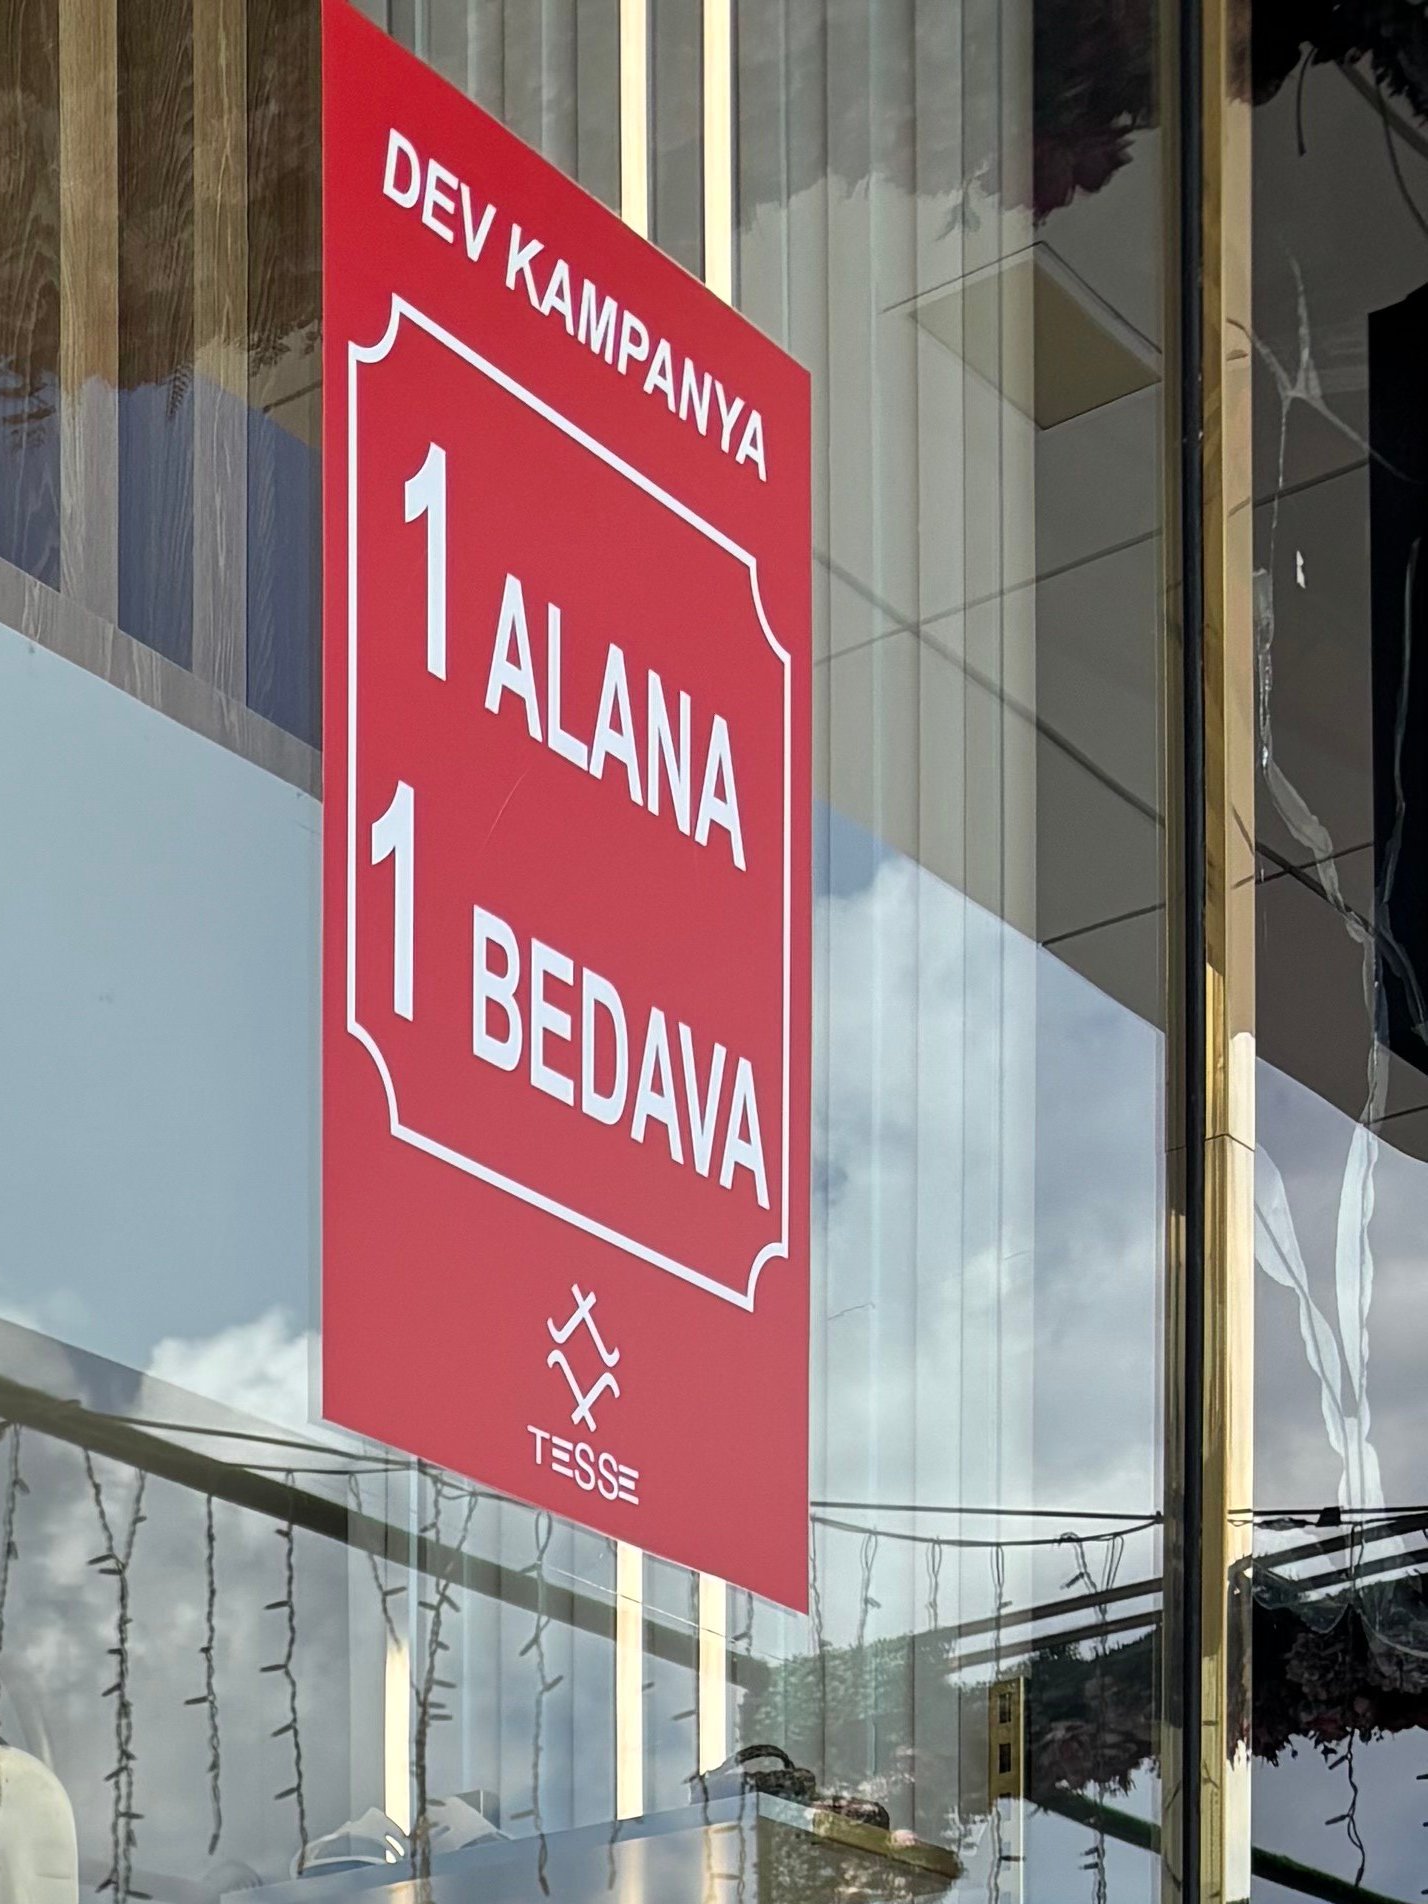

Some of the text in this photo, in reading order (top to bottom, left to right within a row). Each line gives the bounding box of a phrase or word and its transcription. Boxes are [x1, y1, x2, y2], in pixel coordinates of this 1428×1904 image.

[382, 128, 767, 482] DEV KAMPANYA
[404, 441, 748, 872] 1 ALANA
[371, 780, 772, 1211] 1 BEDAVA
[526, 1424, 640, 1506] TESSE
